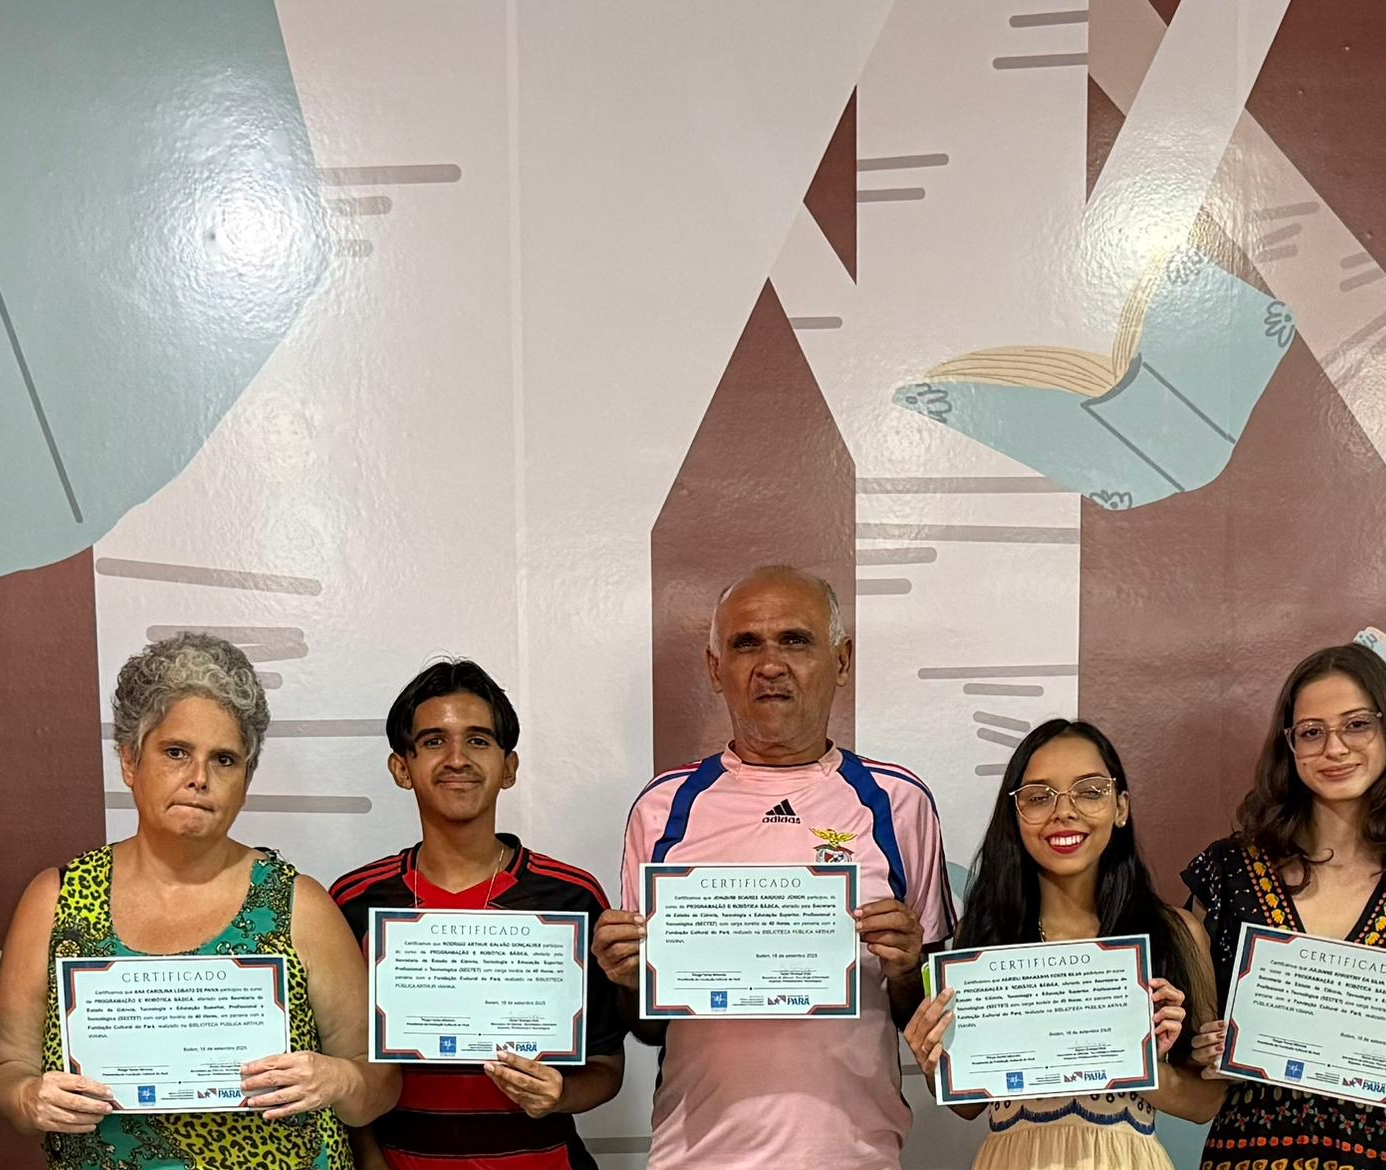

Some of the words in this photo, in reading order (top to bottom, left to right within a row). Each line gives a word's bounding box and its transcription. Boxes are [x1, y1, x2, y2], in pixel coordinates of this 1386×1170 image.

[762, 815, 801, 825] adidas
[700, 877, 800, 889] CERTIFICADO
[430, 924, 530, 936] CERTIFICADO
[989, 952, 1090, 972] CERTIFICADO
[121, 970, 226, 982] CERTIFICADO
